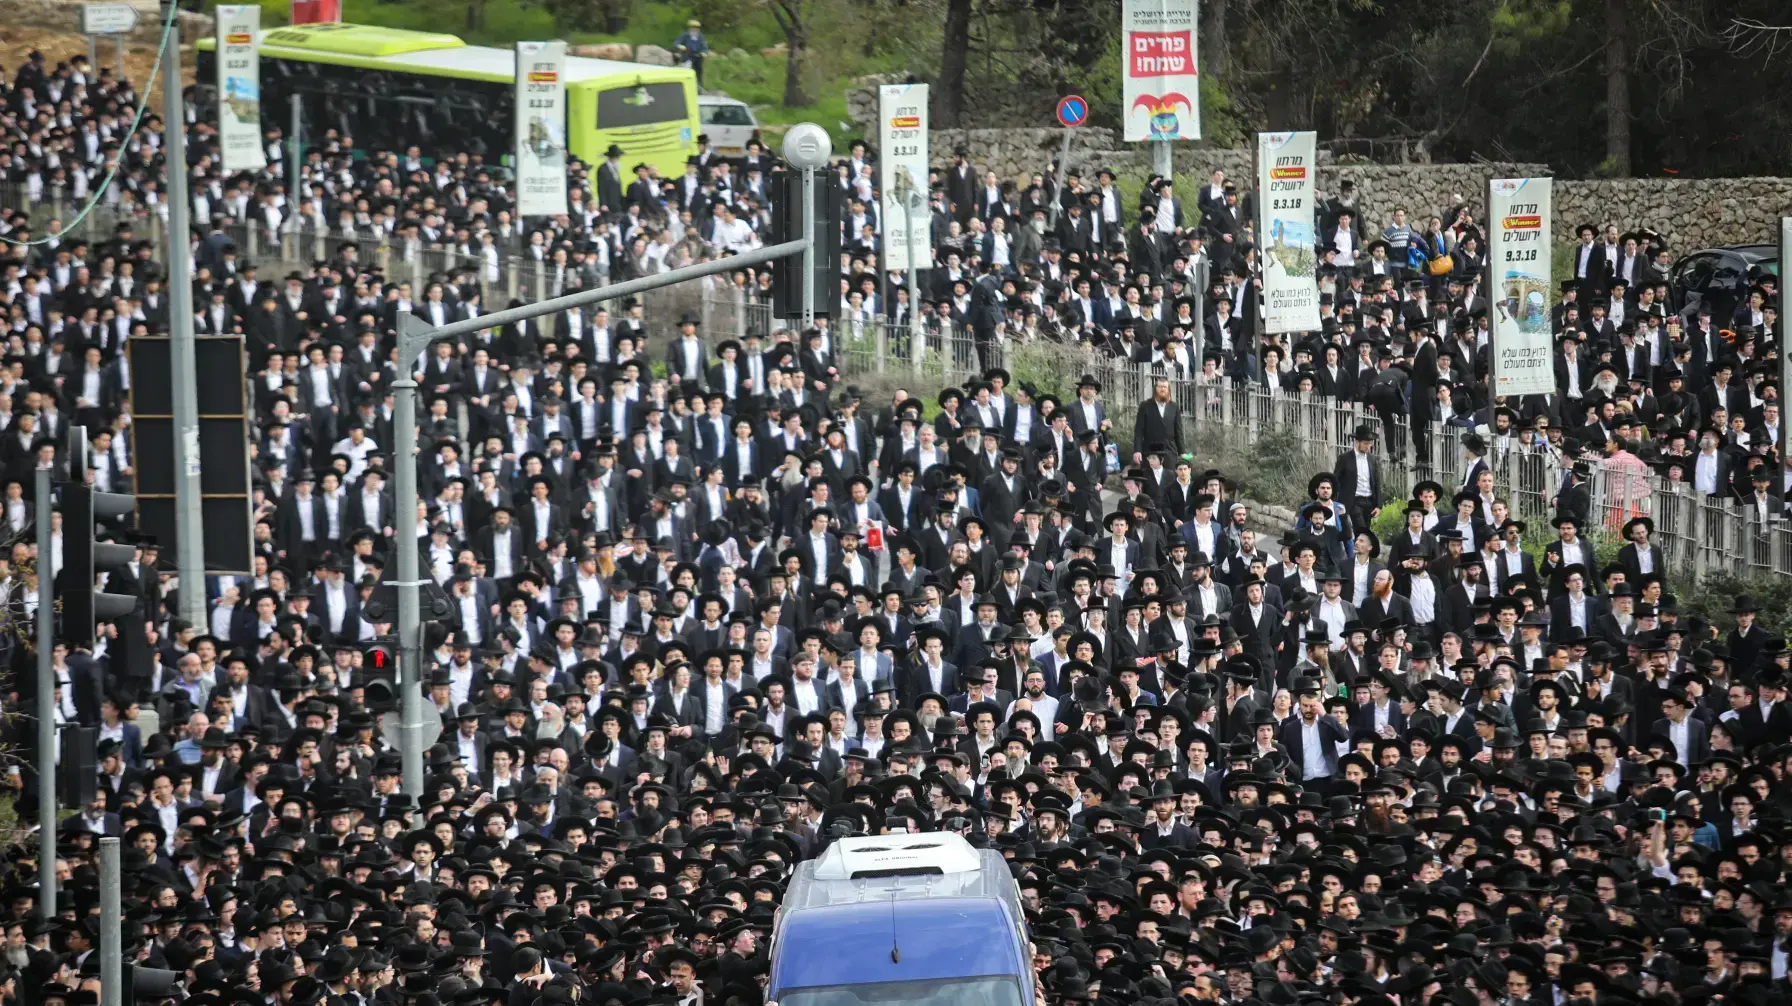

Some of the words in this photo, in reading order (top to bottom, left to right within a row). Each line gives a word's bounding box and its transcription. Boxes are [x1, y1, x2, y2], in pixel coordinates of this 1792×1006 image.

[1133, 9, 1164, 18] ירושלים
[1166, 10, 1191, 18] עיריית
[1135, 36, 1185, 53] פורים
[1136, 55, 1186, 72] שמח!
[896, 106, 918, 117] מרתון
[891, 129, 918, 139] ירושלים
[1276, 155, 1303, 168] מרתון
[1276, 168, 1304, 177] Winner
[1270, 179, 1305, 192] ירושלים
[1273, 199, 1302, 210] 9.3.18
[1509, 203, 1538, 216] מרתון
[1510, 217, 1540, 227] Winner
[1502, 229, 1541, 242] ירושלים
[1505, 249, 1538, 262] 9.3.18
[1271, 288, 1286, 299] שלא
[1286, 289, 1297, 298] כמו
[1297, 287, 1311, 298] לרוץ
[1273, 299, 1293, 309] מעולם
[1294, 298, 1311, 307] רצתם
[1501, 346, 1518, 358] שלא
[1518, 348, 1531, 358] כמו
[1532, 345, 1546, 358] לרוץ
[1503, 358, 1526, 369] מעולם
[1526, 358, 1546, 368] רצתם
